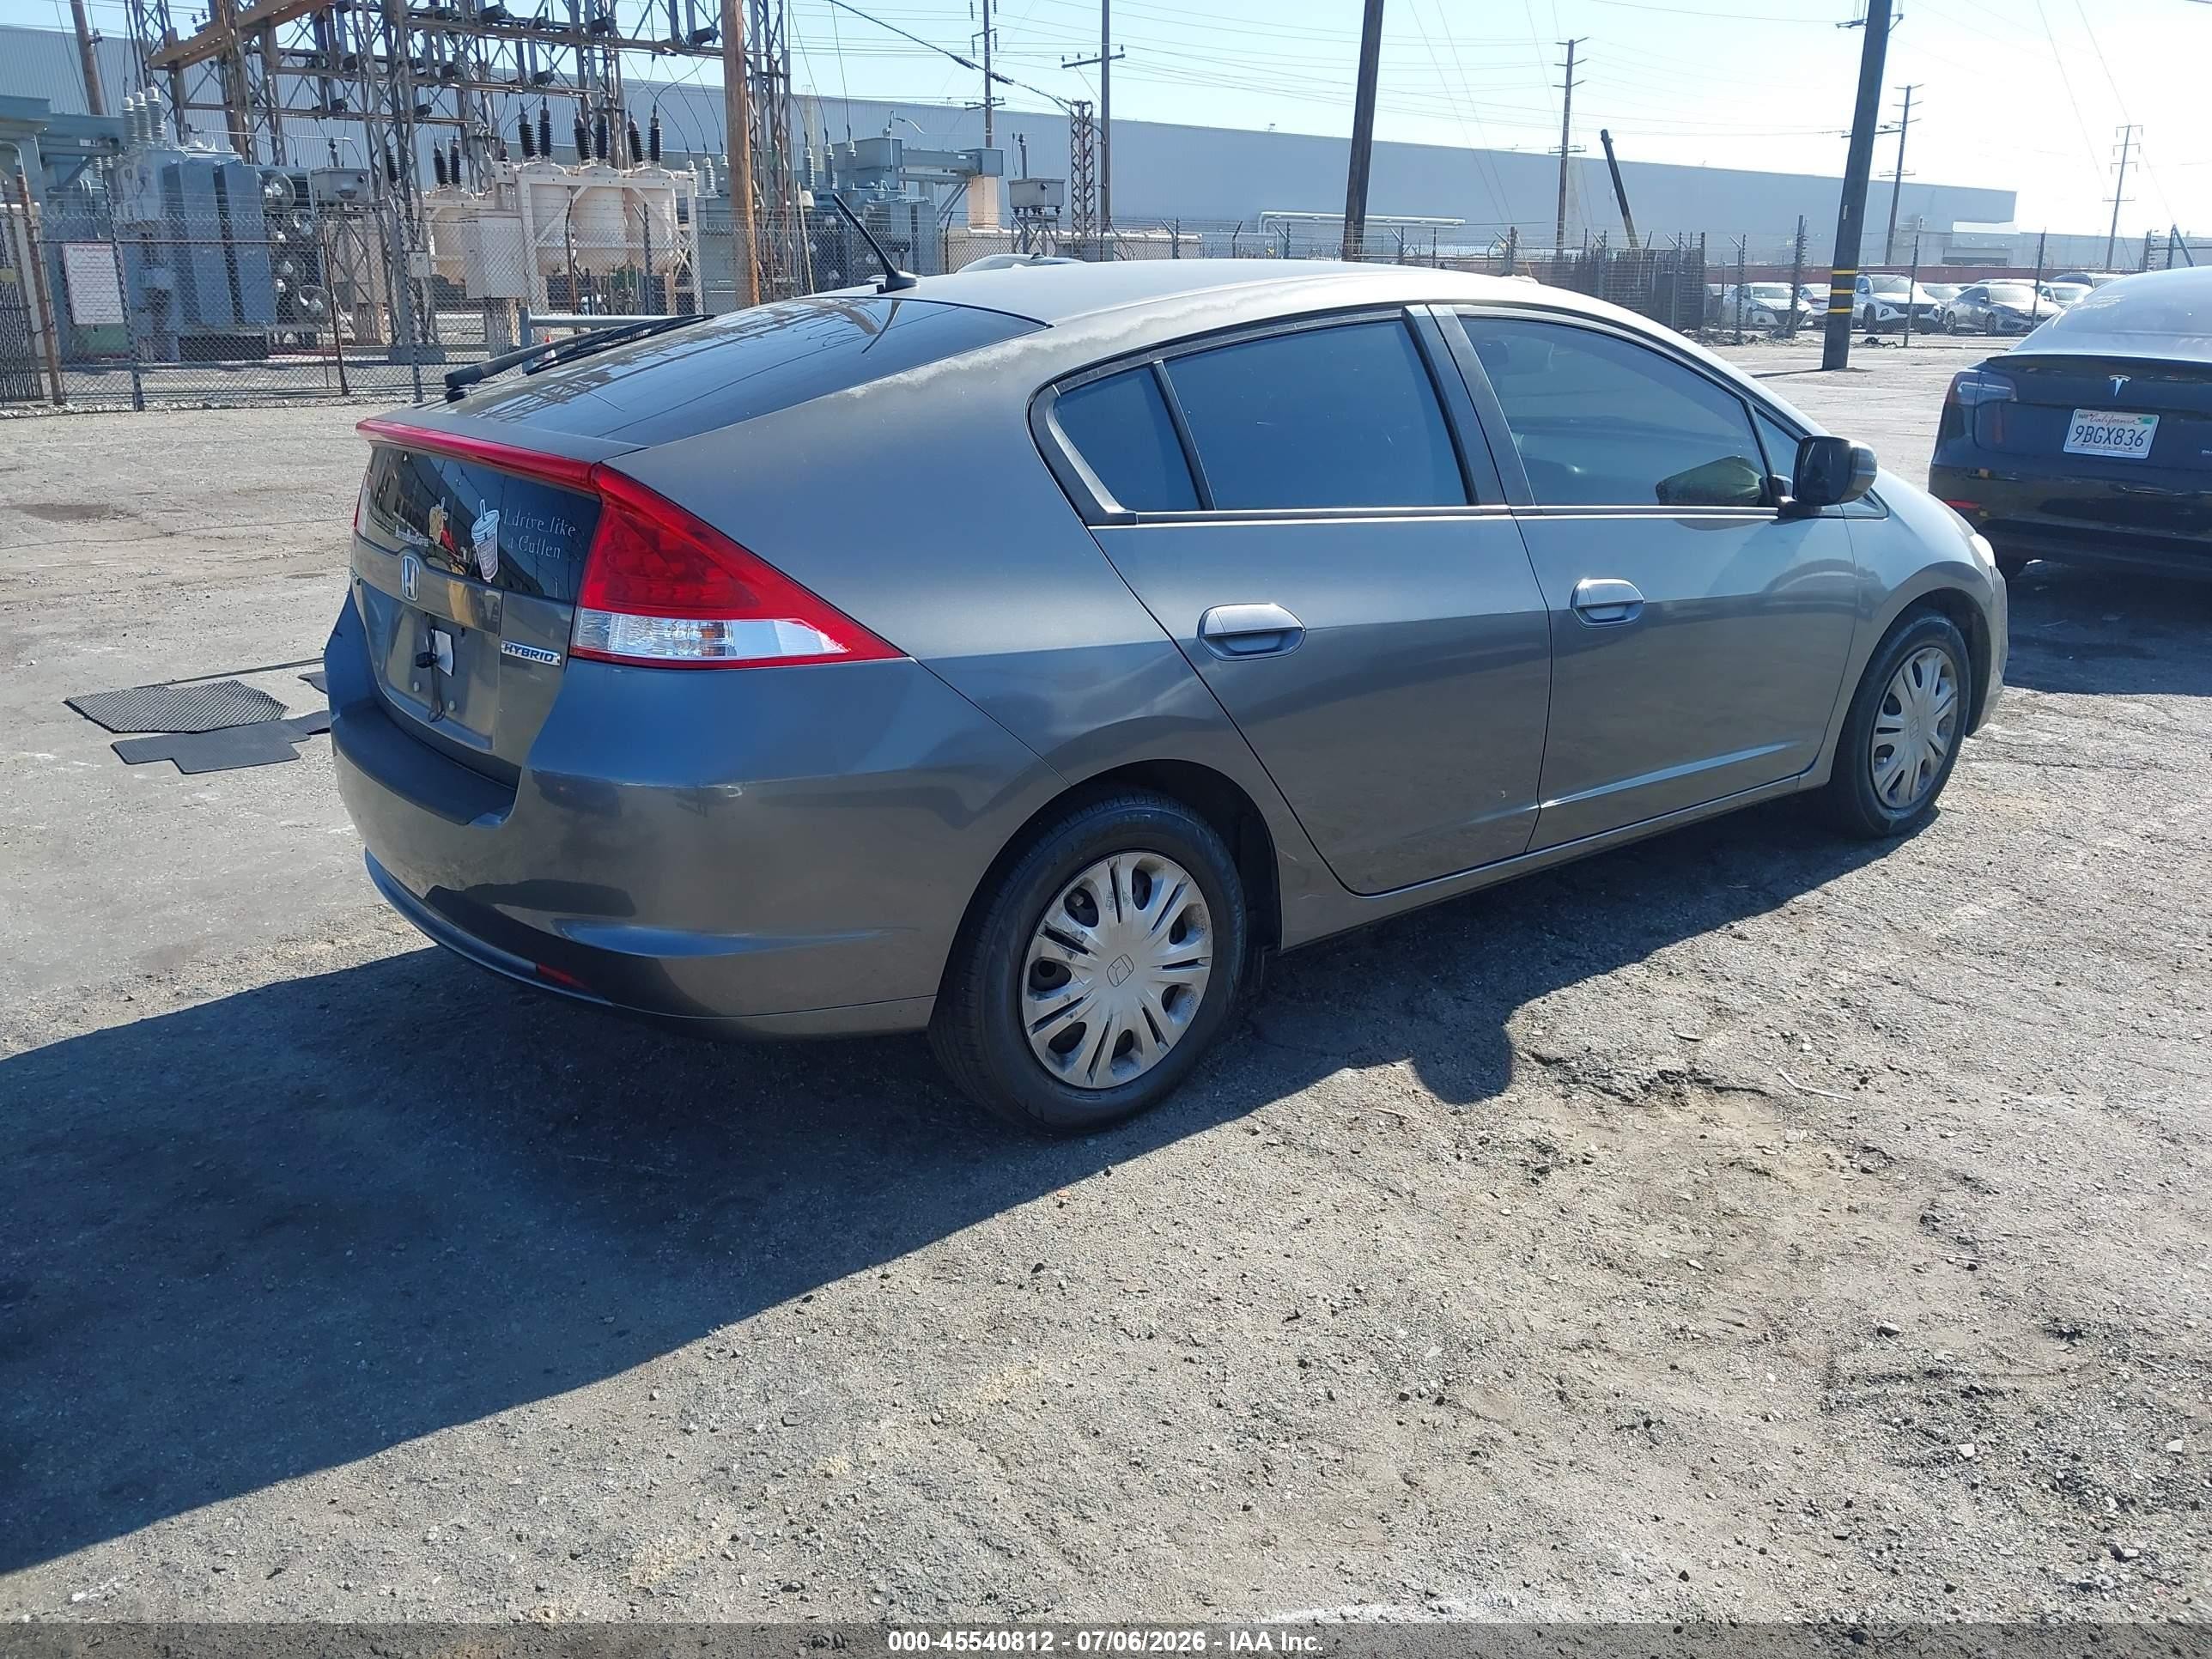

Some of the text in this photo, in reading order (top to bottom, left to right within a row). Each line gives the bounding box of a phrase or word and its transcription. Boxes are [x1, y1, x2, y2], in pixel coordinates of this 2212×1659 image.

[2090, 413, 2140, 426] California
[2072, 425, 2148, 447] 9BGX836
[550, 516, 576, 538] like
[519, 535, 561, 559] Cullen
[503, 642, 555, 663] HYBRID
